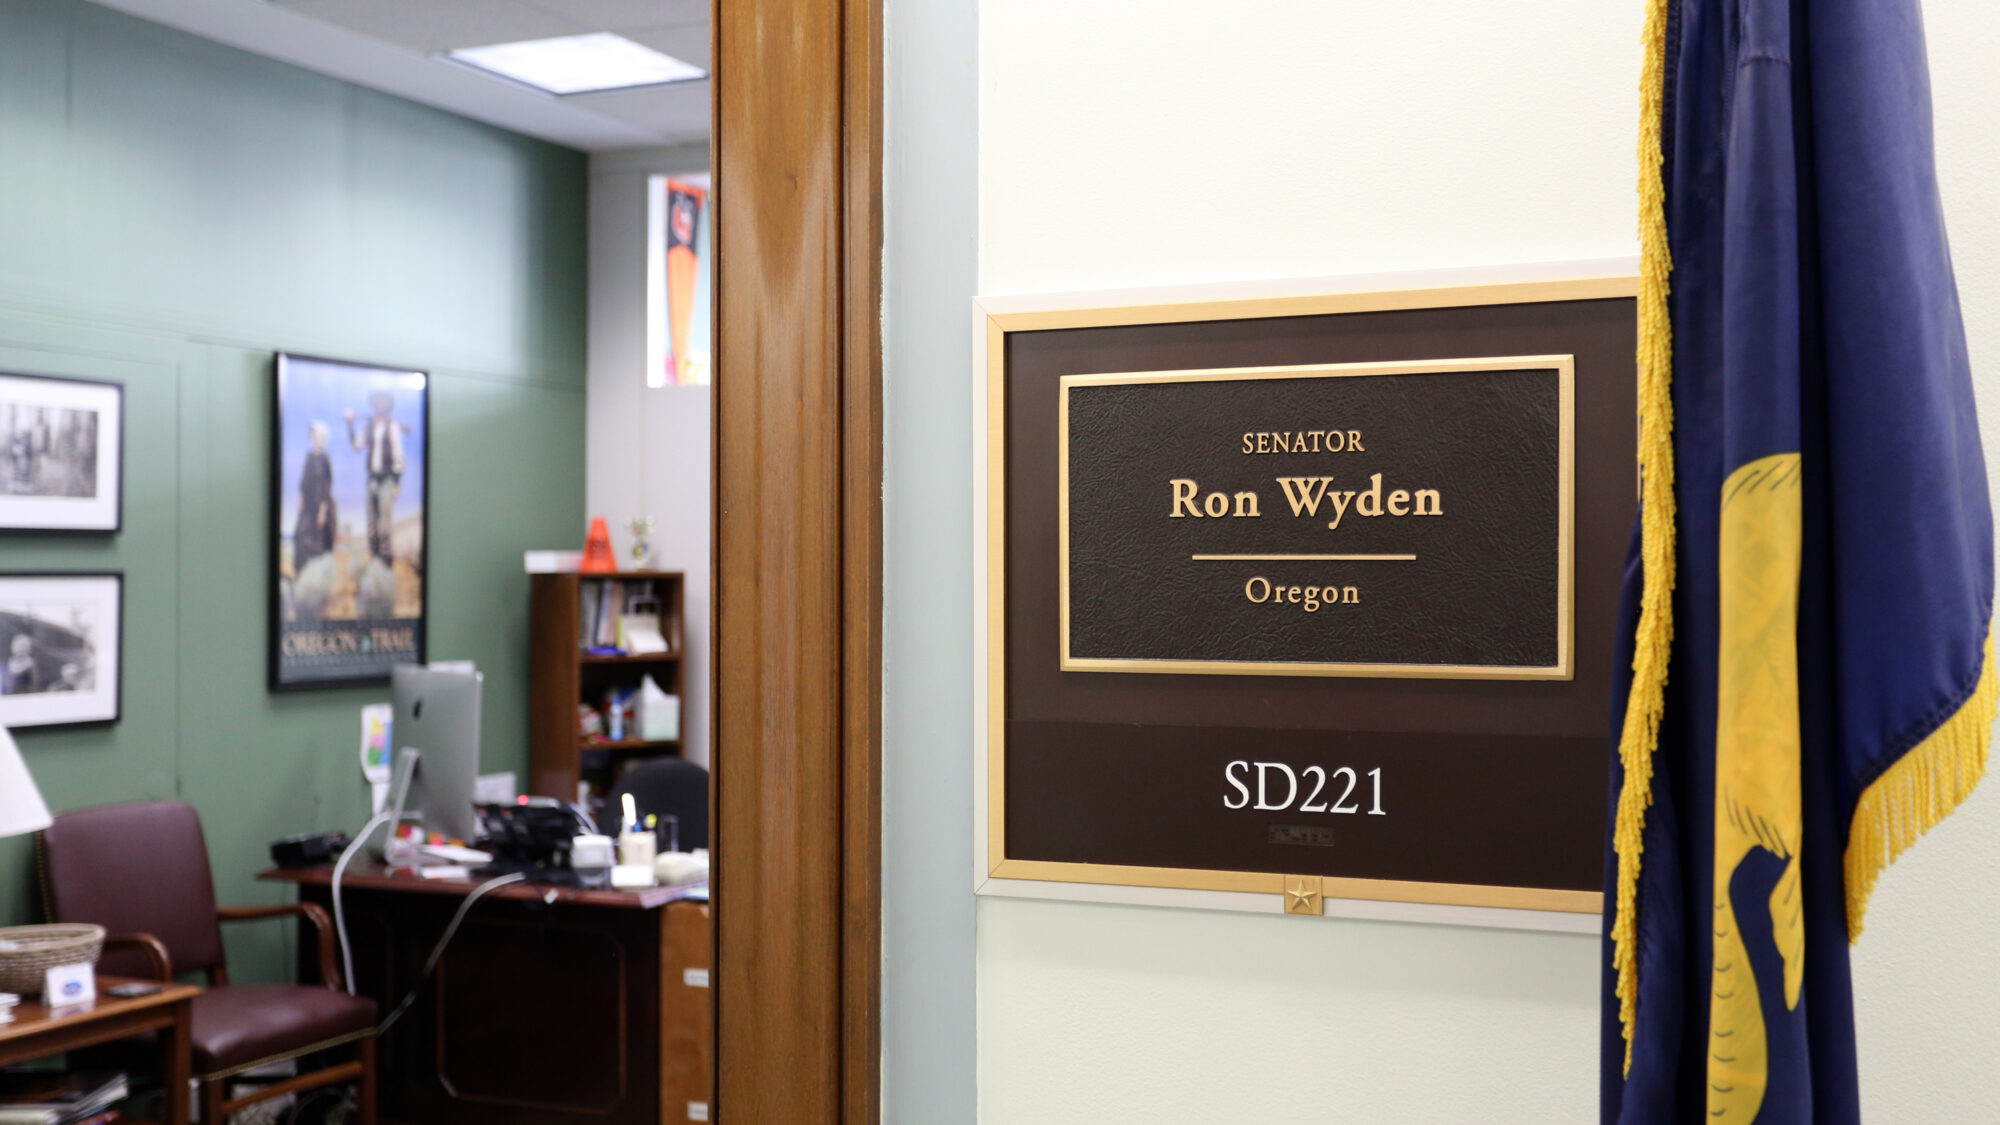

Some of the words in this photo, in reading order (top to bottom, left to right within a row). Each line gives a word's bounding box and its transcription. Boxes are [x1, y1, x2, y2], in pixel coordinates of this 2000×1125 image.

[1242, 430, 1365, 455] SENATOR
[1169, 478, 1261, 518] Ron
[1275, 472, 1444, 530] Wyden
[1244, 576, 1360, 612] Oregon
[281, 628, 358, 657] OREGON
[370, 626, 417, 653] TRAIL
[1223, 760, 1387, 816] SD221
